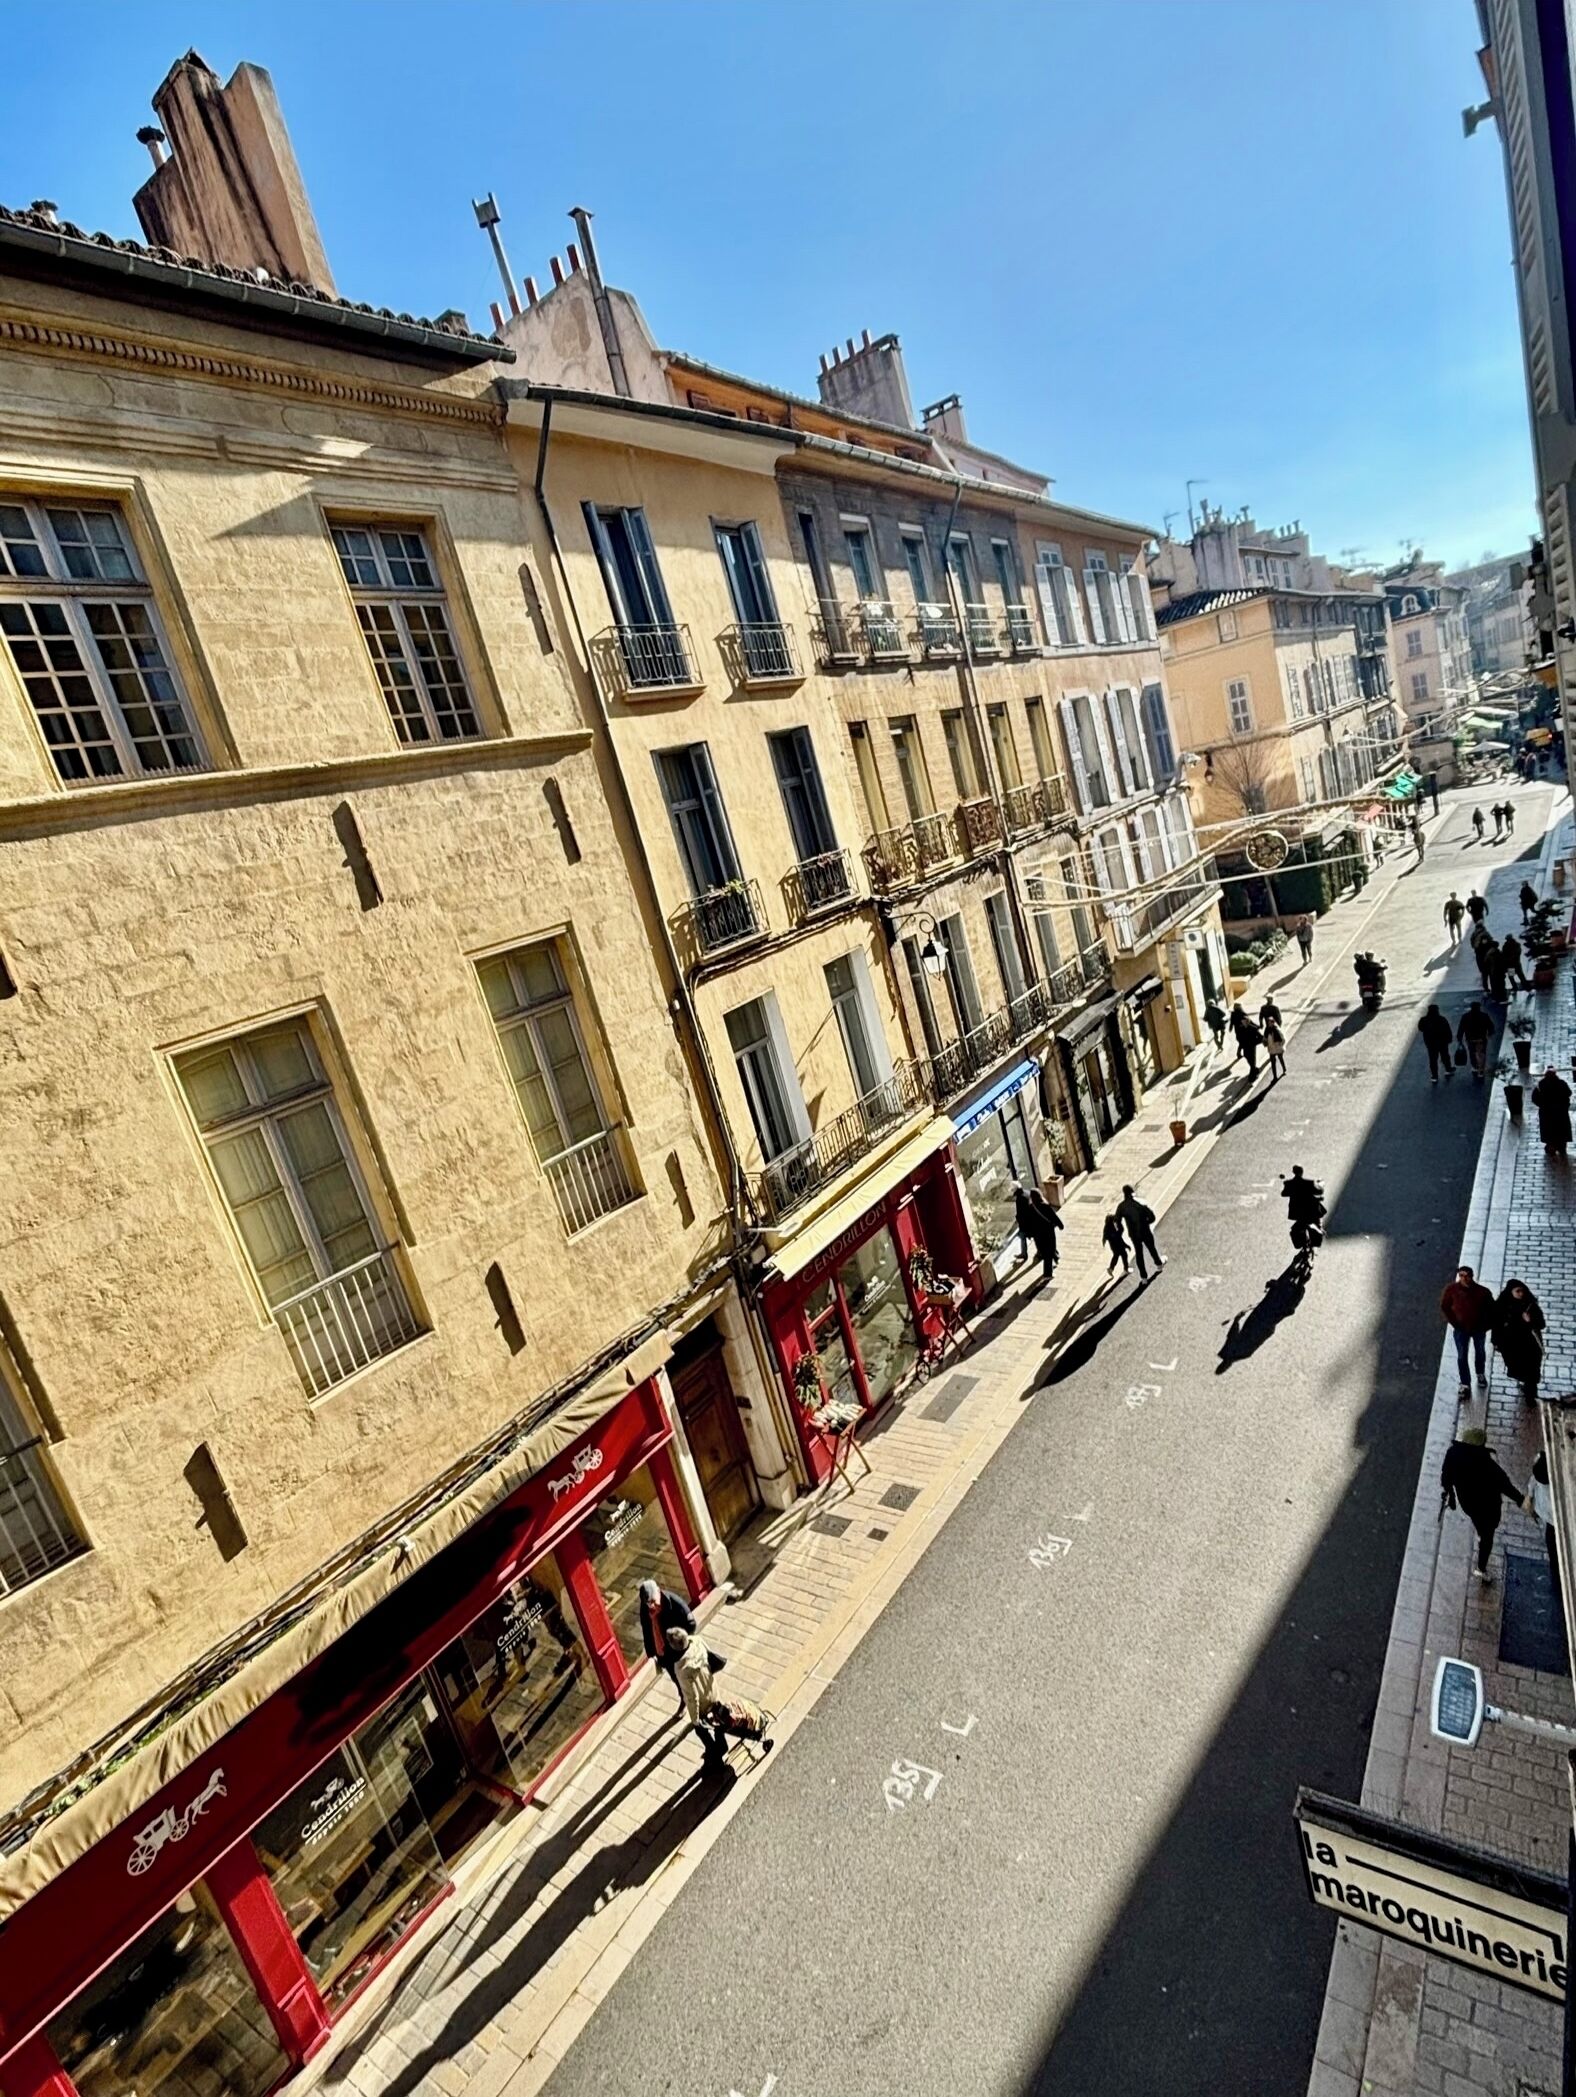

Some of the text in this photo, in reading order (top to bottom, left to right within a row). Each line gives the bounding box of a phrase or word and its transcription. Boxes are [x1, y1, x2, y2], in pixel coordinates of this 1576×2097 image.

[802, 1201, 887, 1282] CENDRILLON
[1029, 1534, 1060, 1570] 136
[497, 1602, 542, 1647] Cendrillon
[301, 1777, 365, 1839] Cendrillon
[882, 1758, 920, 1814] 135
[1303, 1830, 1338, 1869] la
[1311, 1871, 1568, 1989] maroquinerie
